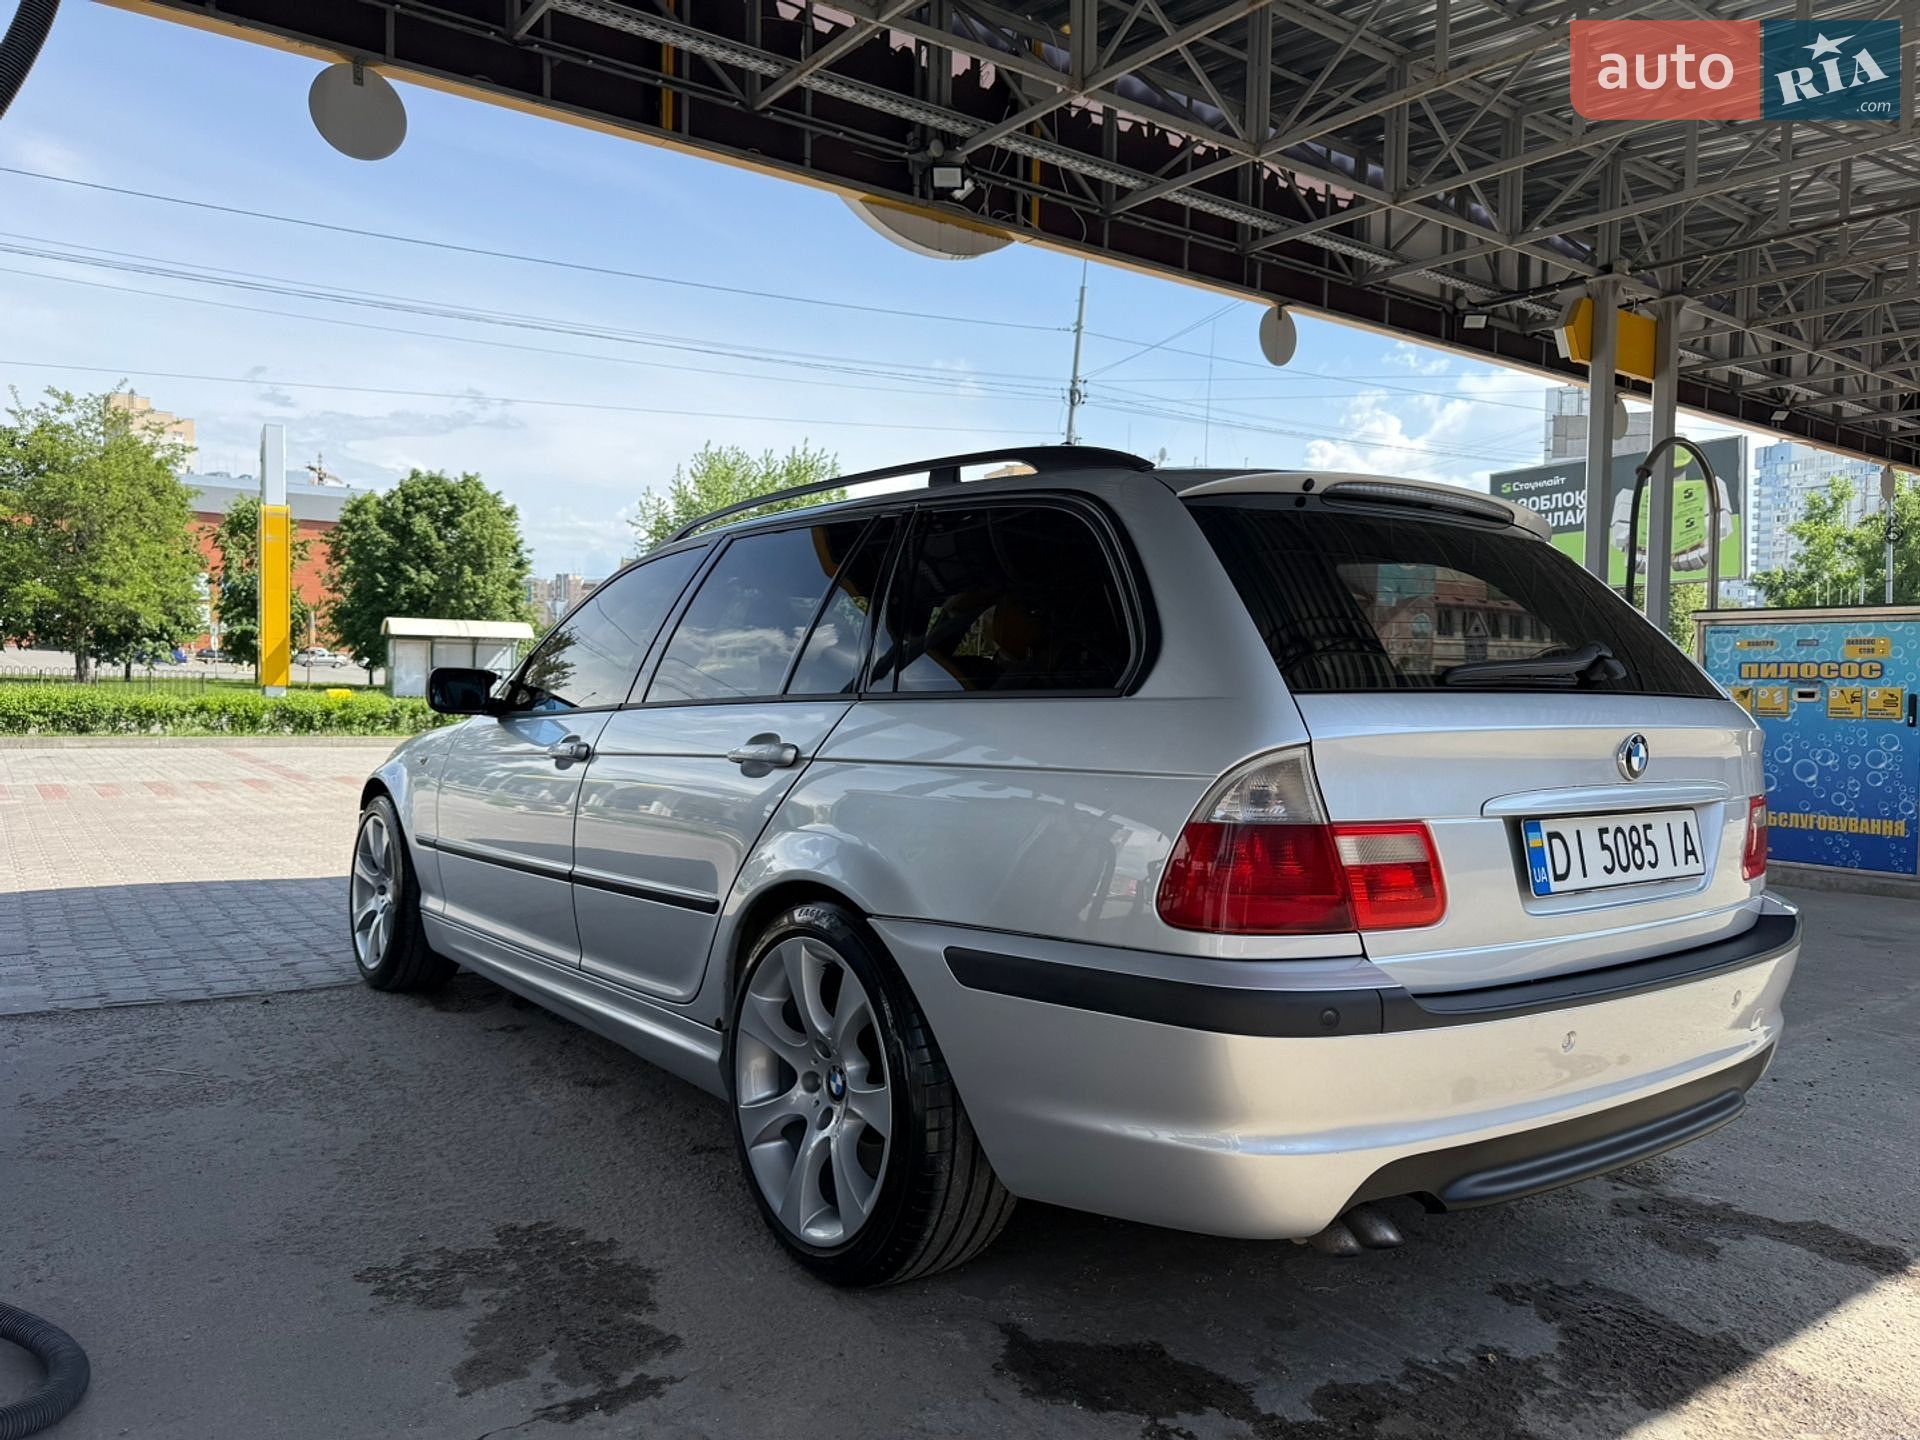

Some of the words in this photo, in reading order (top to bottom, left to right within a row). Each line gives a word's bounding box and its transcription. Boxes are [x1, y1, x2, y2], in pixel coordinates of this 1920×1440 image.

[1739, 661, 1883, 680] ПИЛОСОС
[1768, 811, 1905, 837] БСЛУГОВУВАННЯ
[1547, 829, 1587, 882] DI
[1598, 822, 1659, 875] 5085
[1667, 821, 1700, 867] IA
[1533, 866, 1548, 883] UA
